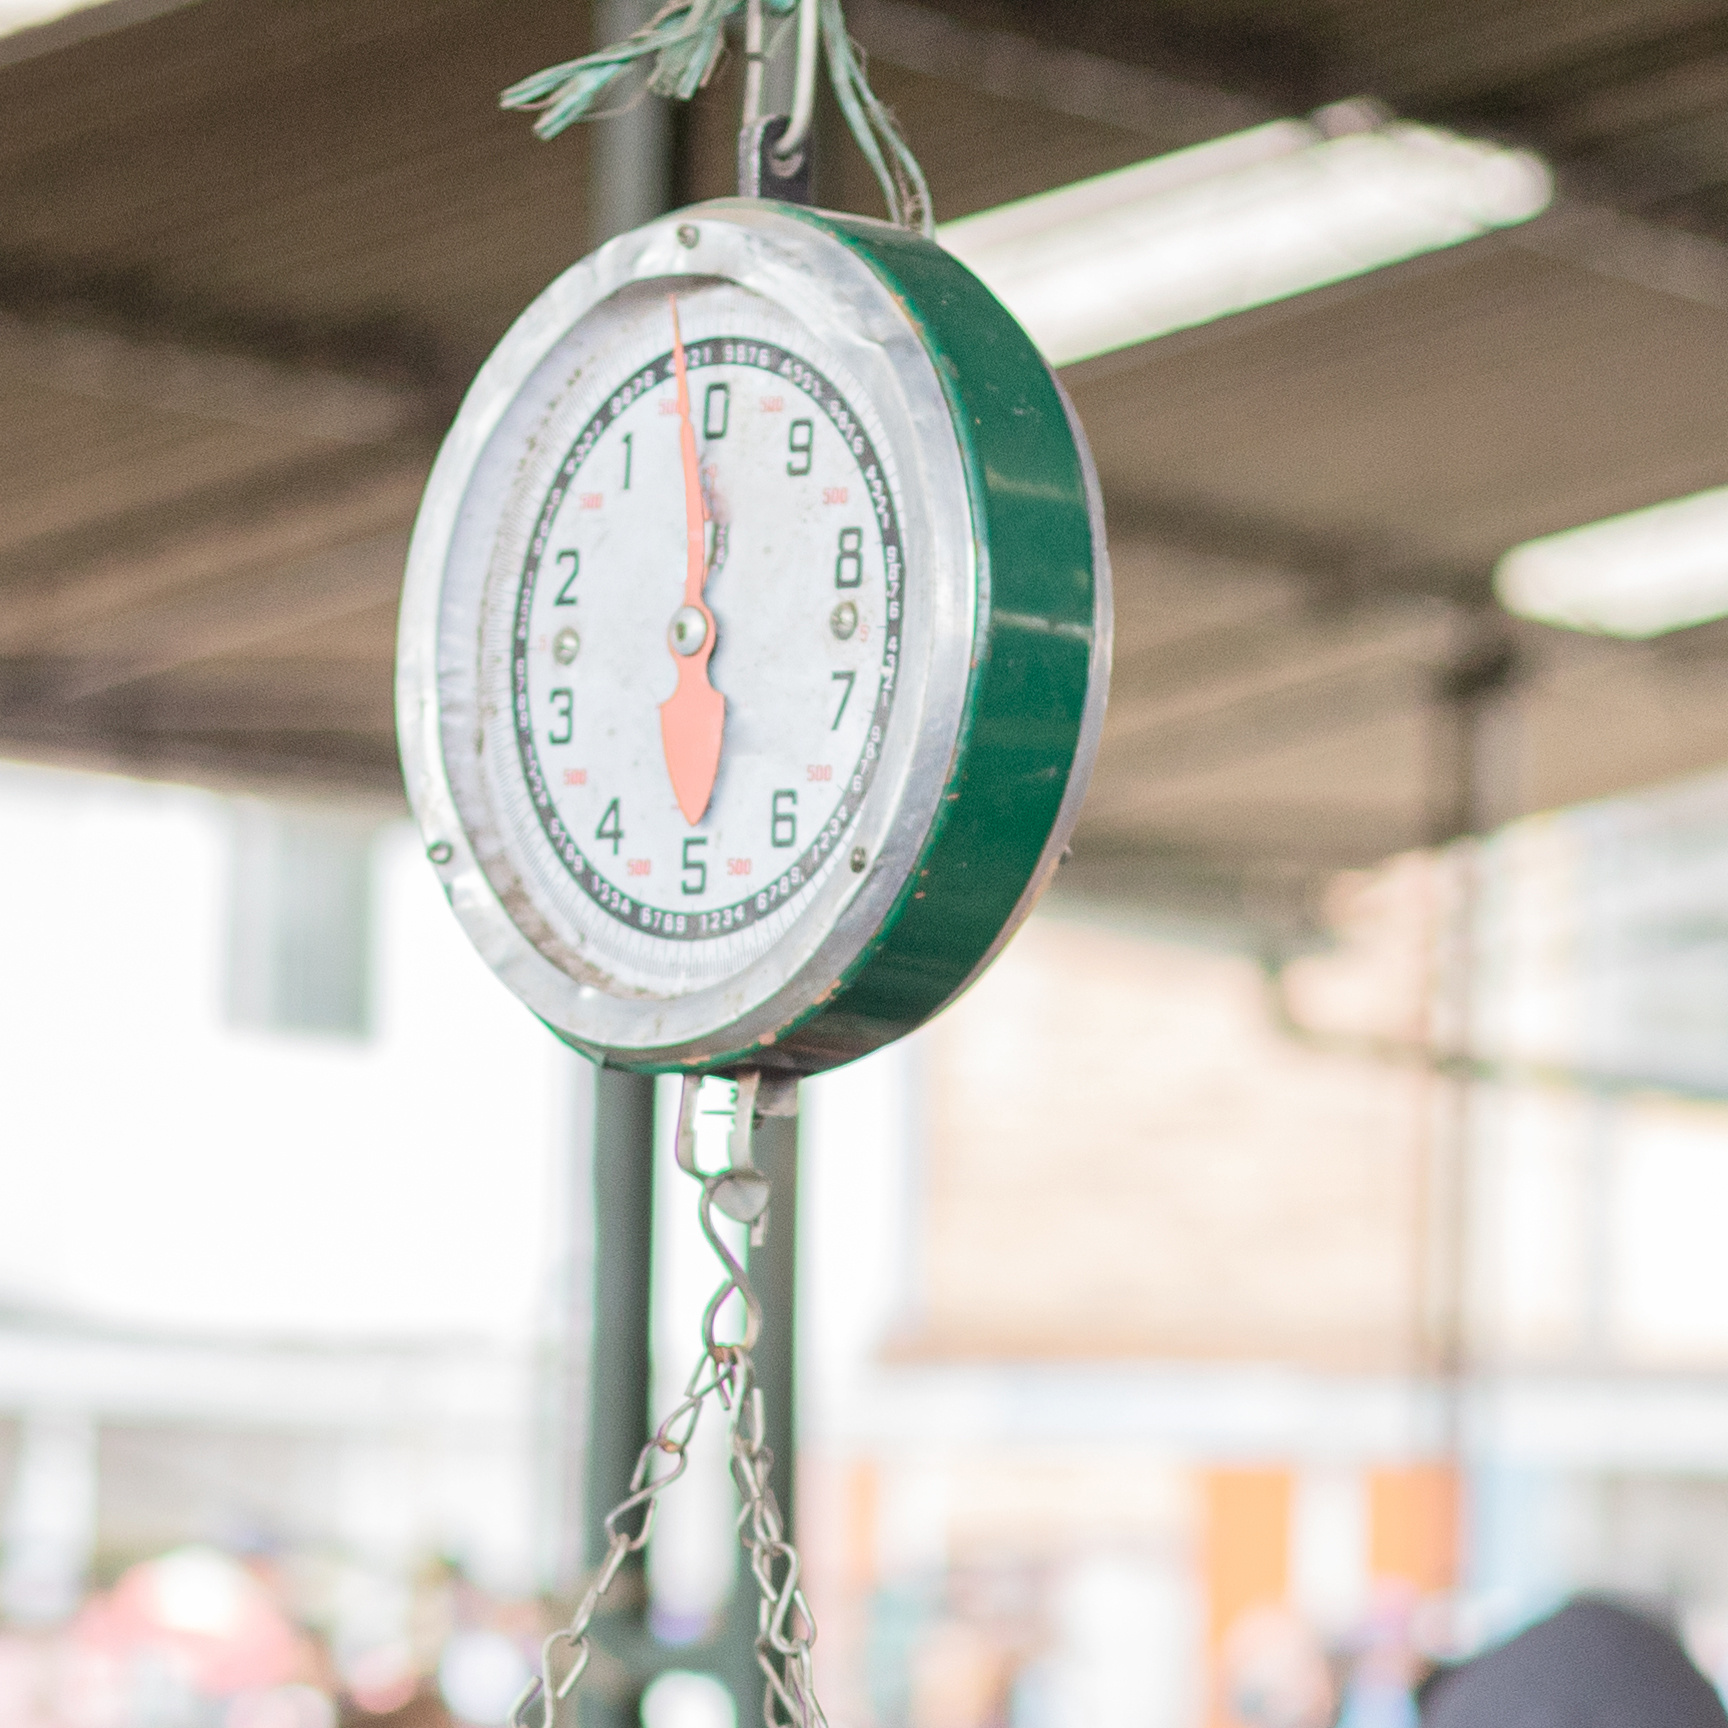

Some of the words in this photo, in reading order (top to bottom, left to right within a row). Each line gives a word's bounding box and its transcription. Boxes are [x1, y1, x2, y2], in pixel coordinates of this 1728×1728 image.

[778, 358, 821, 398] 4321
[703, 381, 730, 440] 0
[622, 431, 632, 490] 1
[787, 418, 813, 476] 9
[554, 548, 580, 606] 2
[835, 526, 863, 589] 8
[549, 687, 573, 745] 3
[831, 670, 857, 731] 7
[807, 765, 832, 781] 500
[595, 797, 625, 856] 4
[771, 788, 798, 848] 6
[681, 836, 708, 895] 5
[727, 858, 752, 875] 500
[640, 907, 685, 933] 6789
[700, 904, 745, 931] 1234
